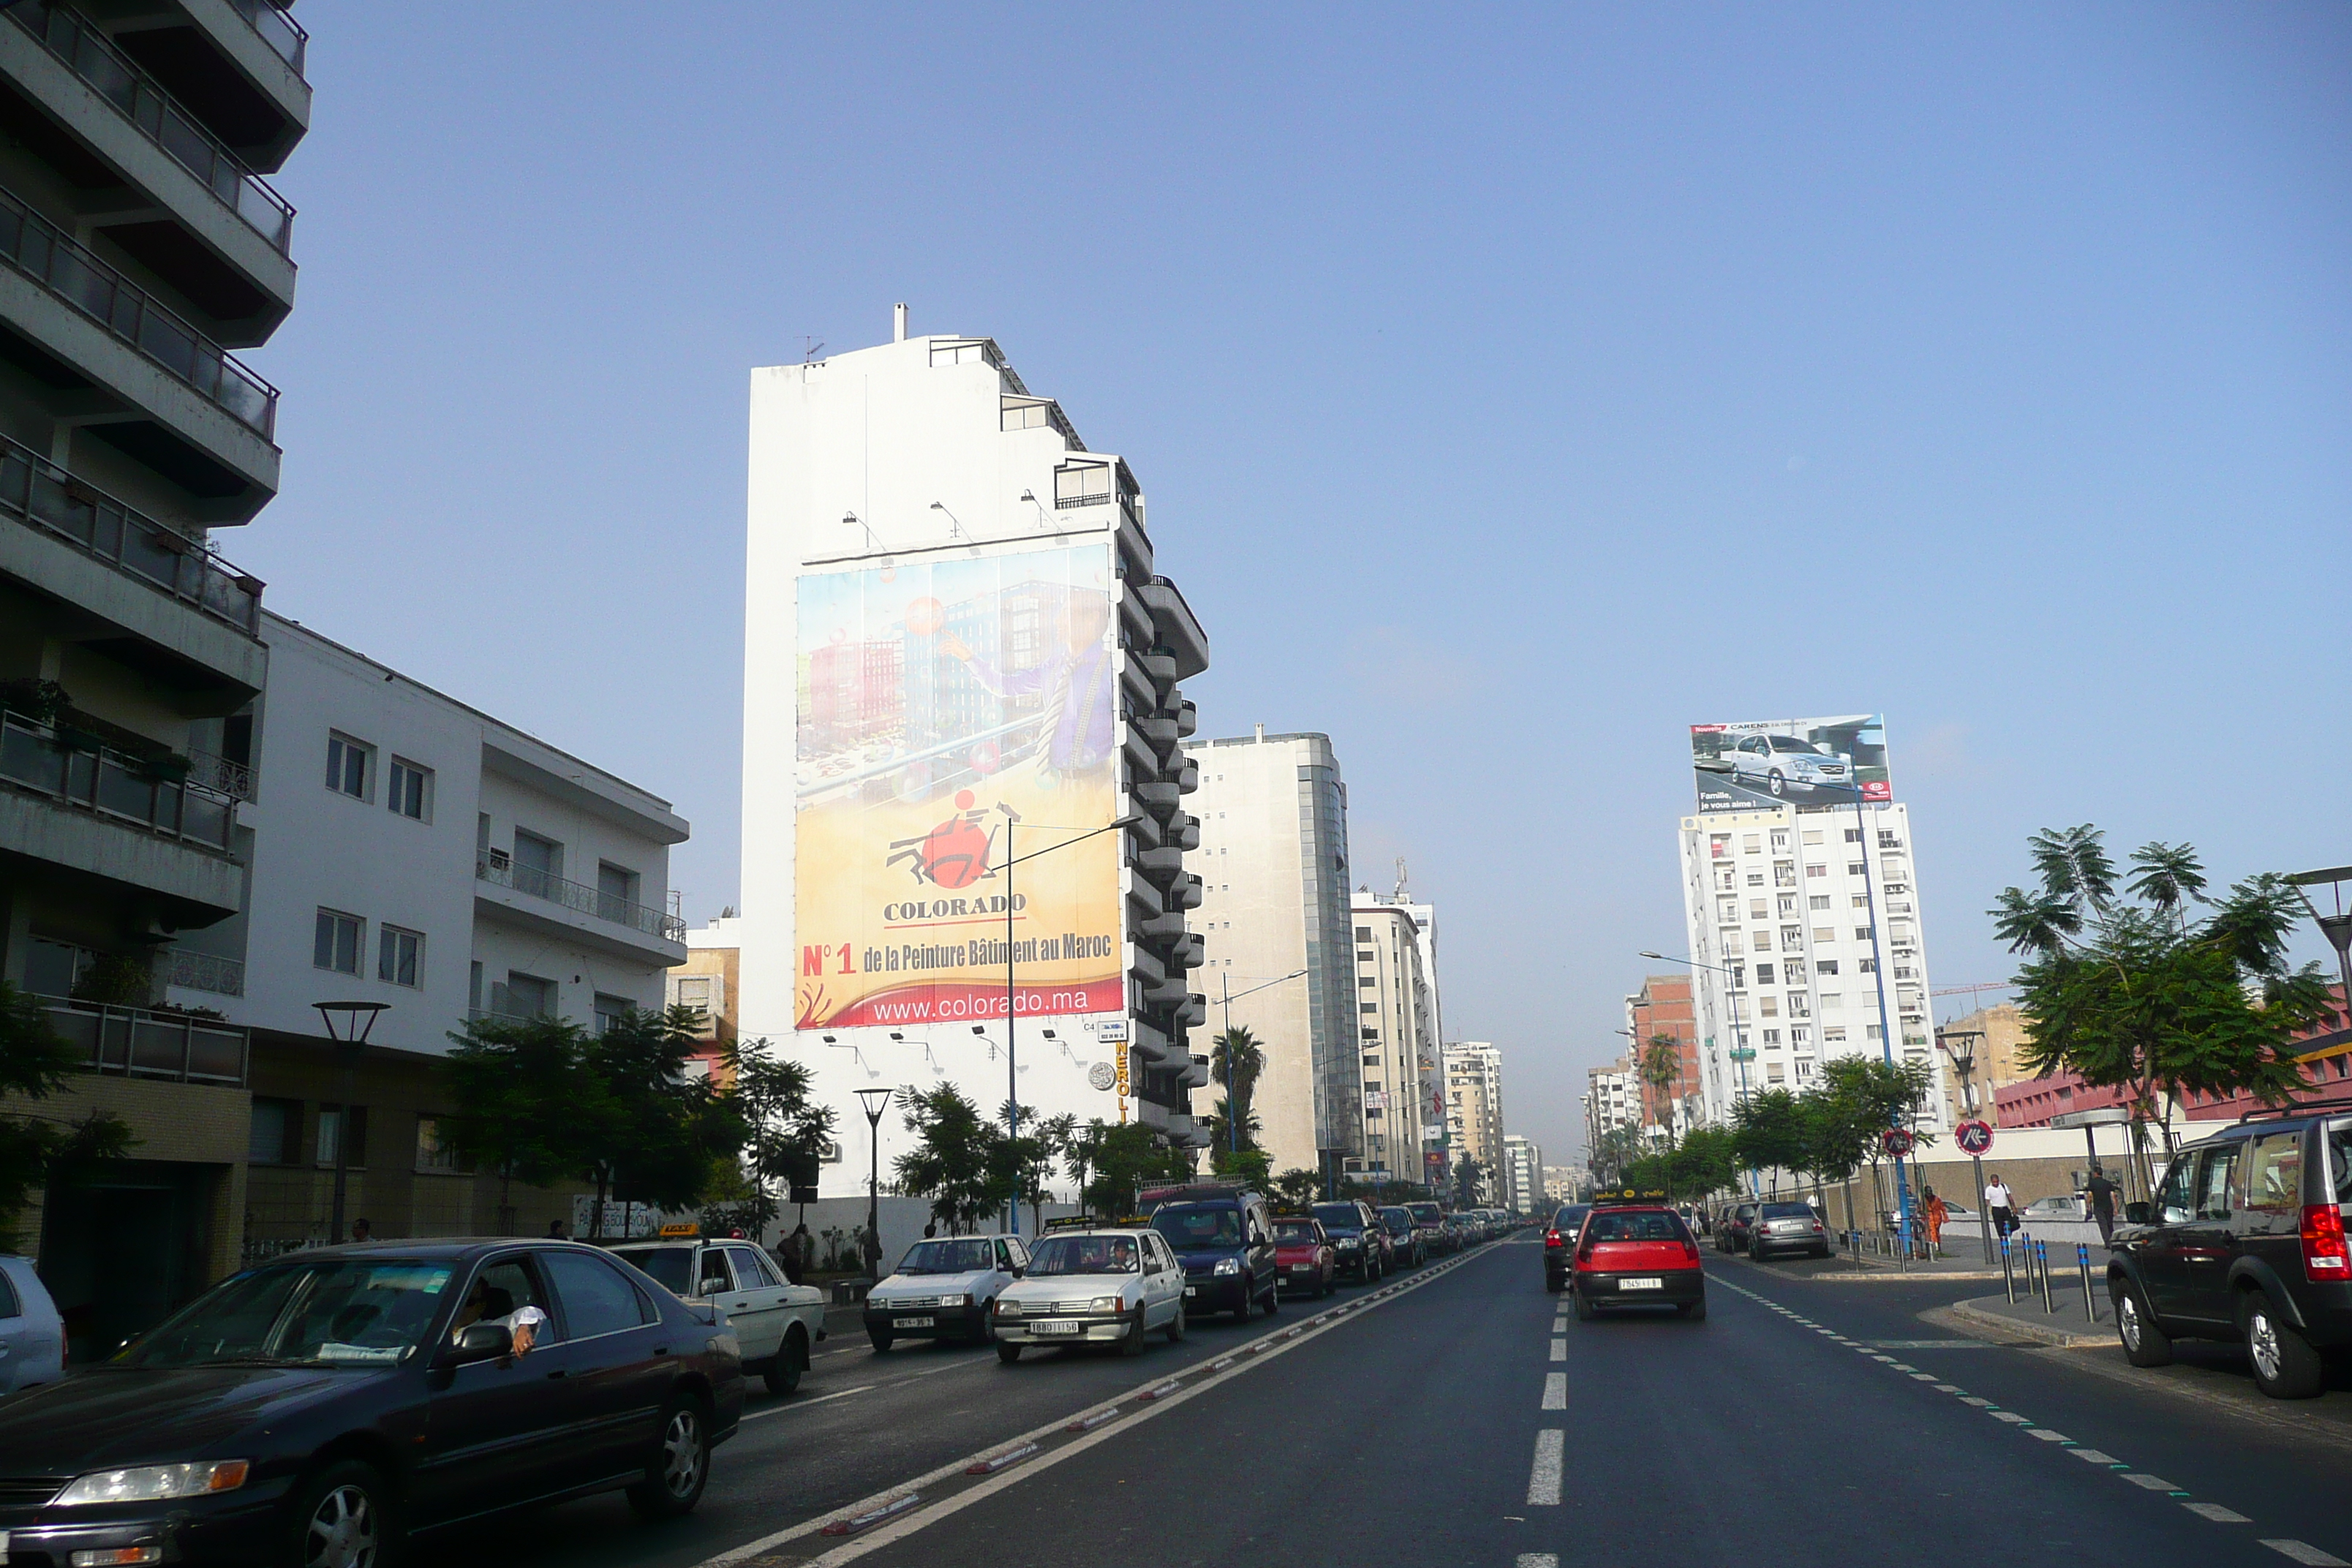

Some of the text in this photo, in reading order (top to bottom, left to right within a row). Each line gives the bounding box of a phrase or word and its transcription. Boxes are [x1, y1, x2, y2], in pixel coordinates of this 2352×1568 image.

[1700, 791, 1732, 799] Famille,
[1731, 800, 1752, 808] aime
[883, 893, 1027, 921] COLORADO
[864, 946, 882, 973] de
[886, 946, 900, 971] la
[902, 943, 965, 970] Peinture
[968, 938, 1038, 966] Bâtiment
[1041, 938, 1059, 962] au
[1063, 932, 1112, 960] Maroc
[874, 990, 1088, 1020] www.colorado.ma
[1084, 1023, 1095, 1031] C4
[1115, 1041, 1129, 1124] NEROLI
[666, 1224, 692, 1232] TAXI
